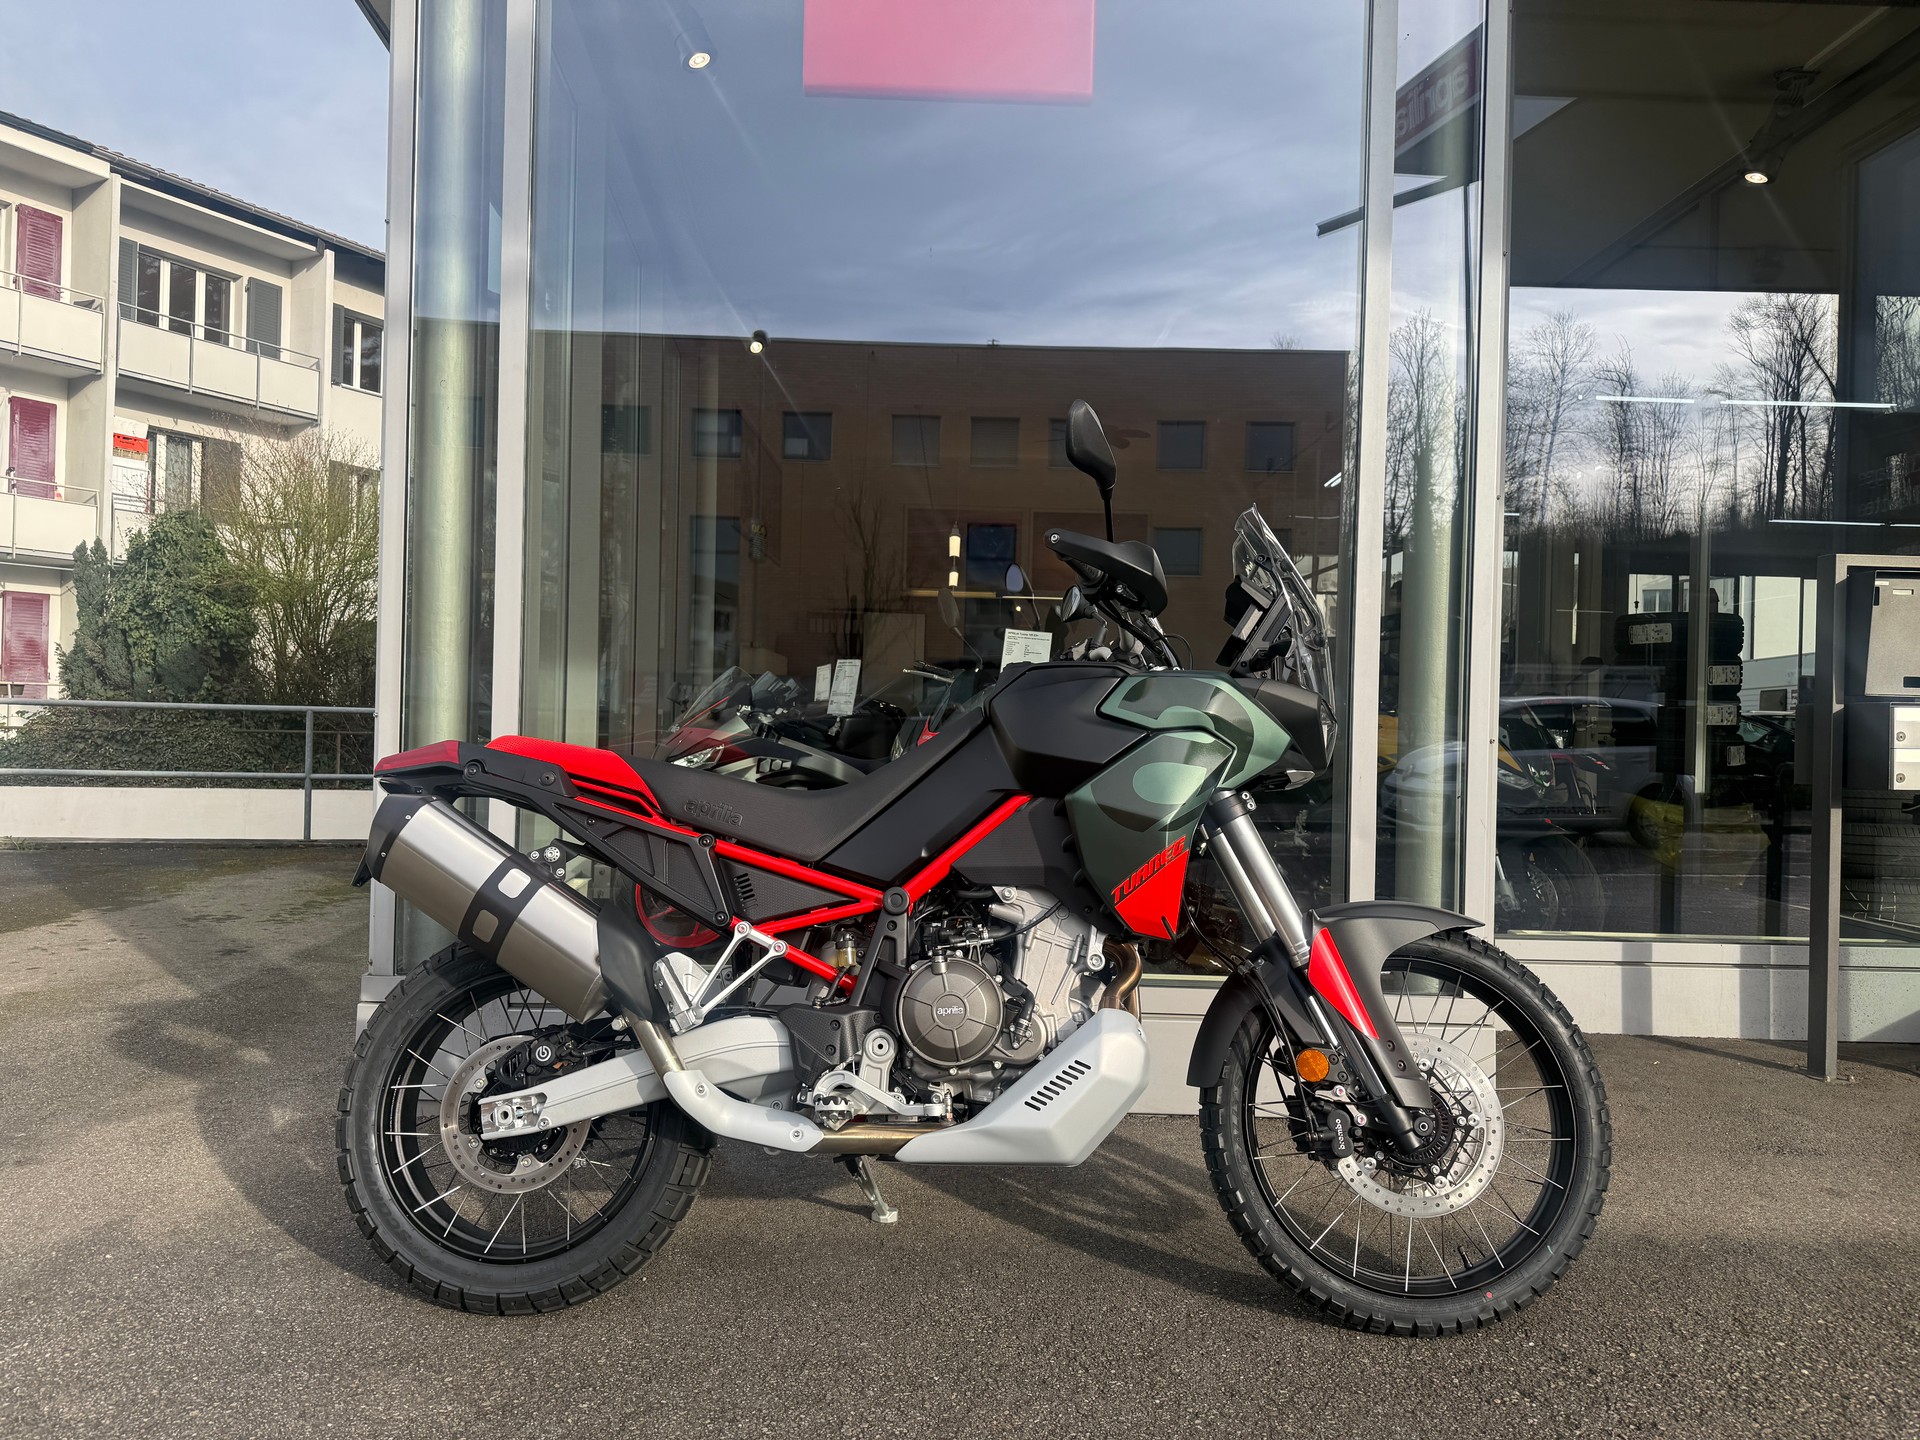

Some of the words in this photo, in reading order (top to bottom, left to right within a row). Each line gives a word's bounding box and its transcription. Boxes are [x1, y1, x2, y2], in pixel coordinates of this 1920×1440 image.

[684, 799, 743, 827] aprilia
[1111, 835, 1187, 904] TUAREG
[937, 1005, 963, 1016] aprilia
[1335, 1118, 1346, 1150] brembo
